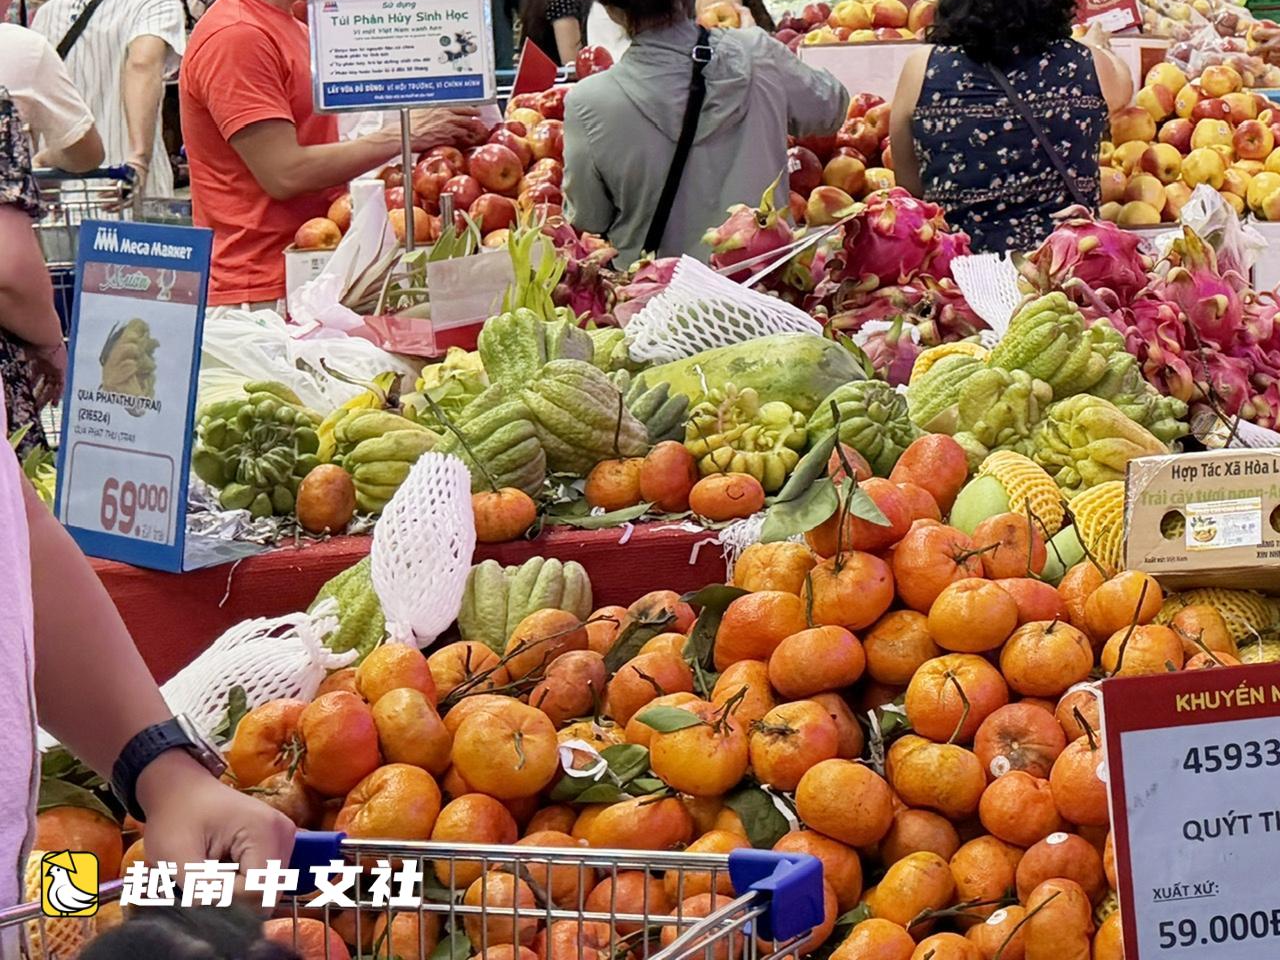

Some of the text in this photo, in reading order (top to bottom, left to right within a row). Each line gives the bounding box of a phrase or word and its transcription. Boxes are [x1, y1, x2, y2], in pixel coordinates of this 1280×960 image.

[353, 14, 384, 25] Phân
[416, 10, 442, 22] Sinh
[445, 8, 469, 22] Học
[1171, 464, 1198, 482] Hợp
[1201, 462, 1222, 478] Tác
[1224, 460, 1241, 476] Xã
[1244, 460, 1269, 475] Hòa
[1175, 679, 1265, 712] KHUYẾN
[1182, 810, 1253, 842] QUÝT
[1153, 880, 1219, 900] XUẤT XỨ:
